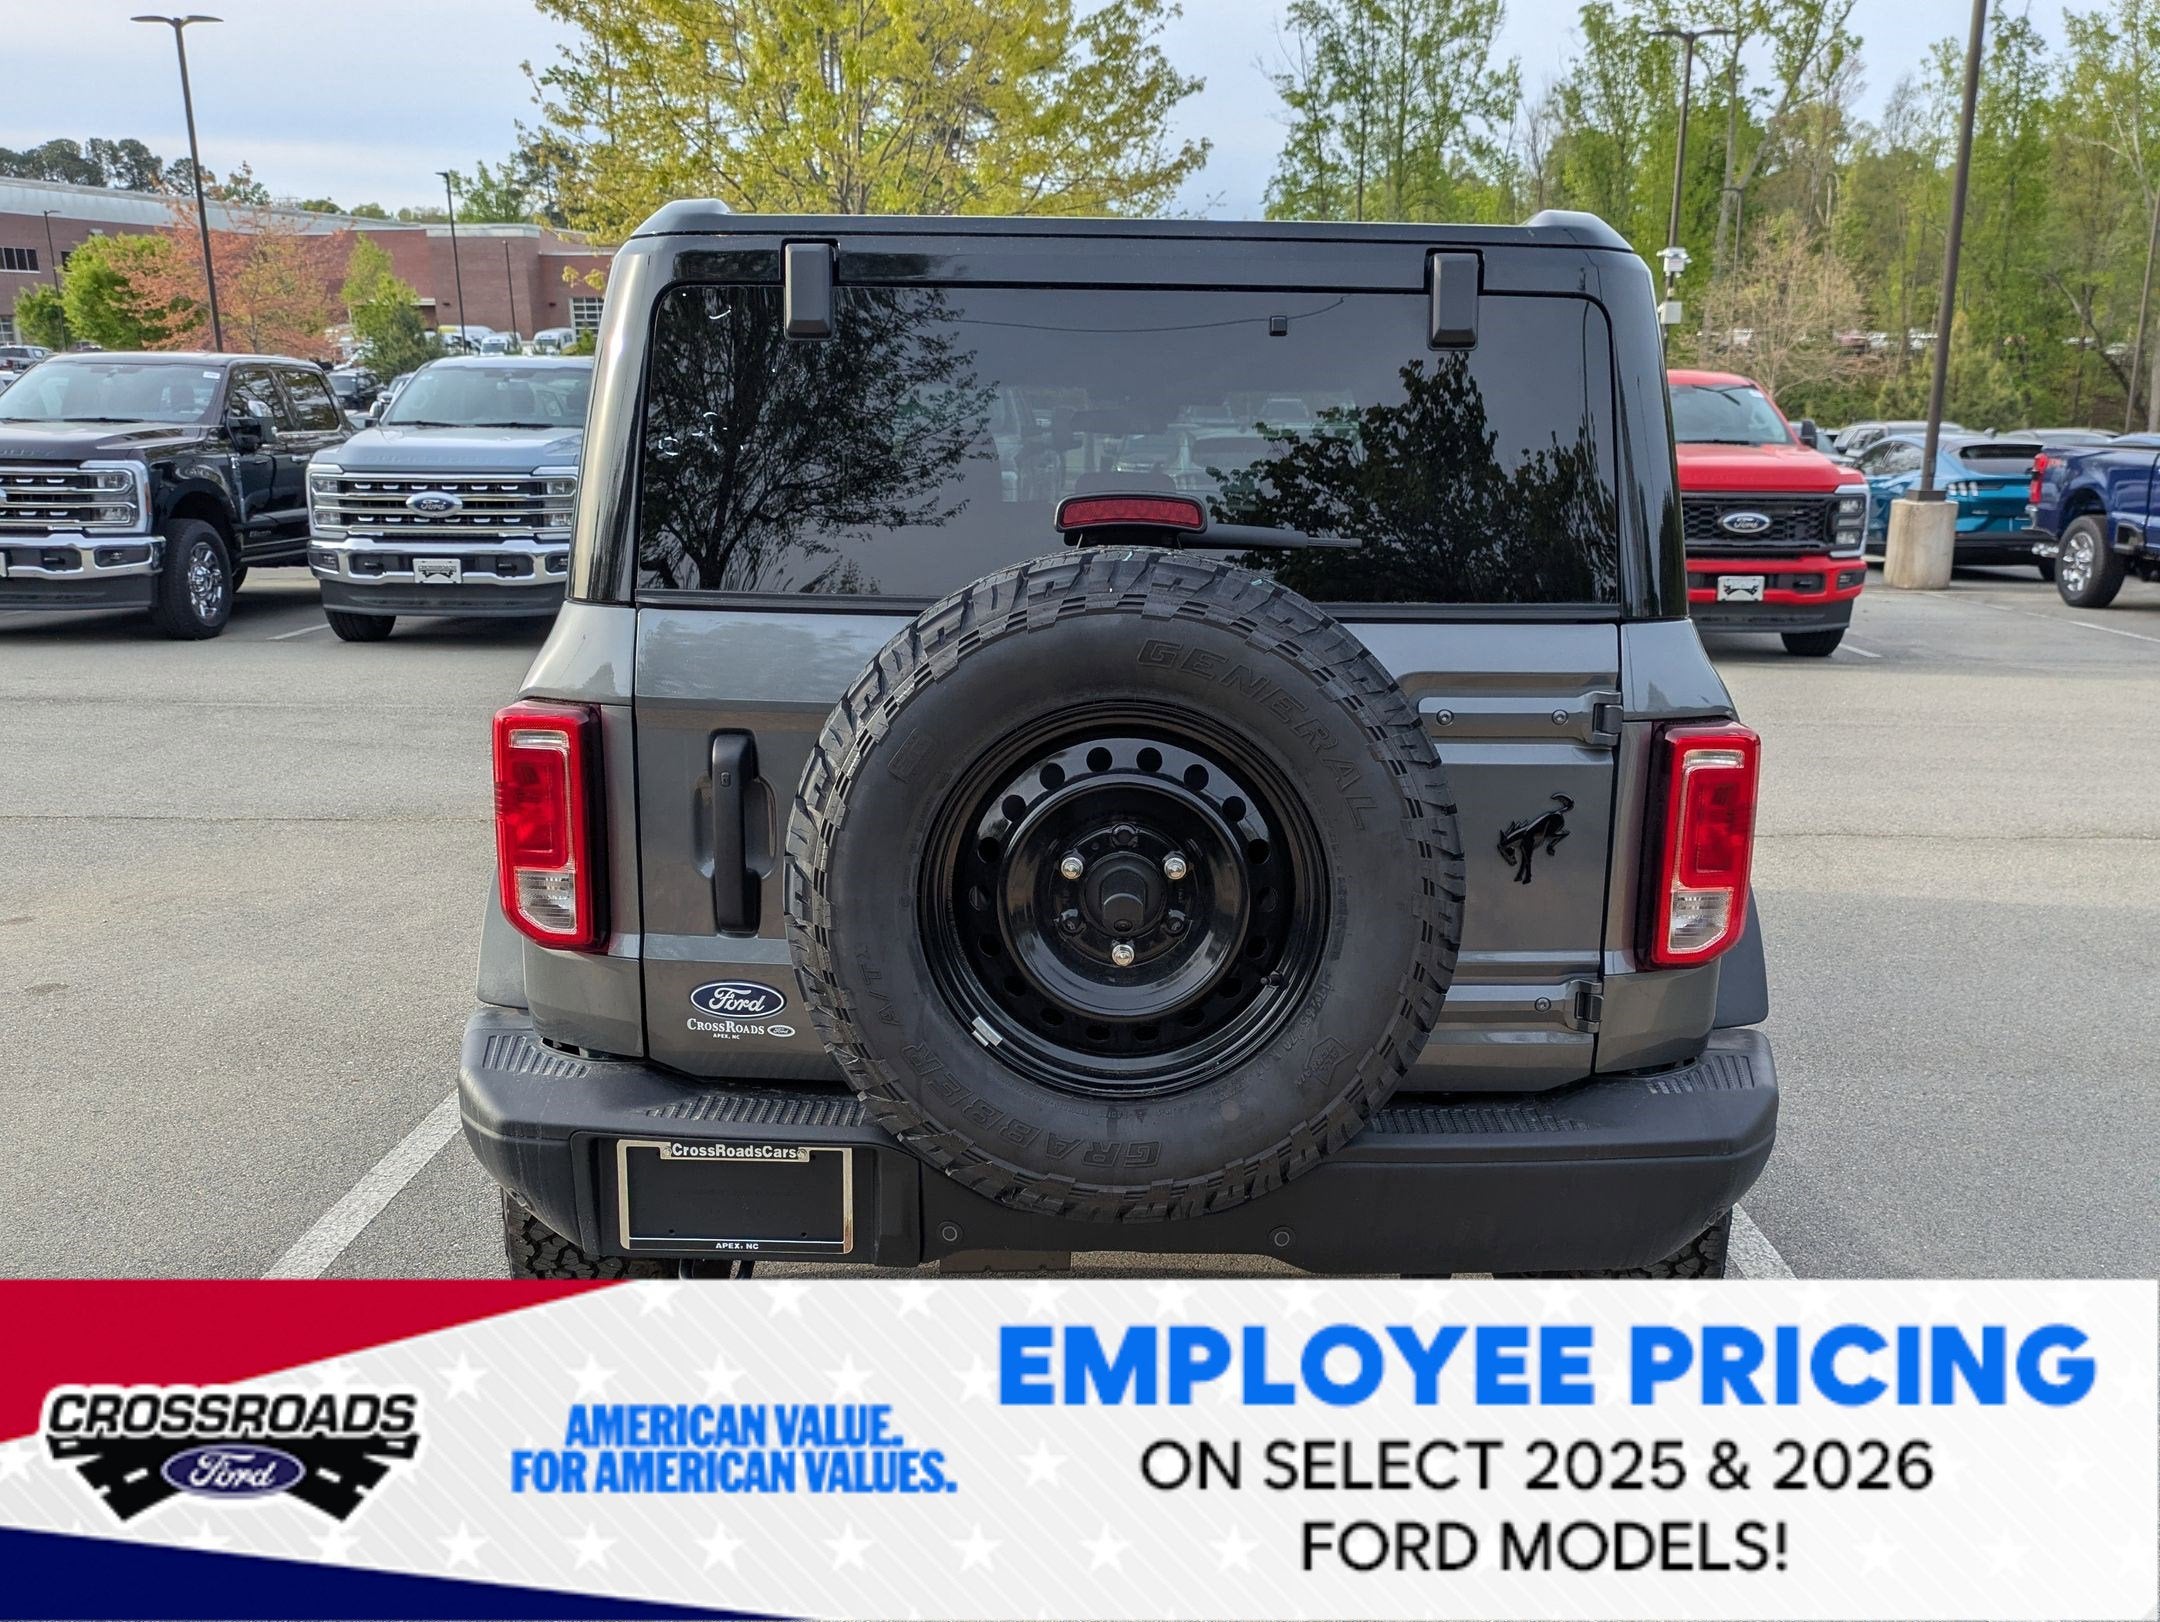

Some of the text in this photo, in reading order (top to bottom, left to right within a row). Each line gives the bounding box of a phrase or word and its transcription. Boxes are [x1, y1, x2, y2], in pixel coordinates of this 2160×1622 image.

[420, 499, 446, 511] Ford
[1733, 517, 1759, 529] Ford
[1136, 639, 1378, 832] GENERAL
[708, 987, 766, 1012] Ford
[900, 1039, 1163, 1168] GRABBER
[672, 1142, 797, 1158] CrossRoadsCars
